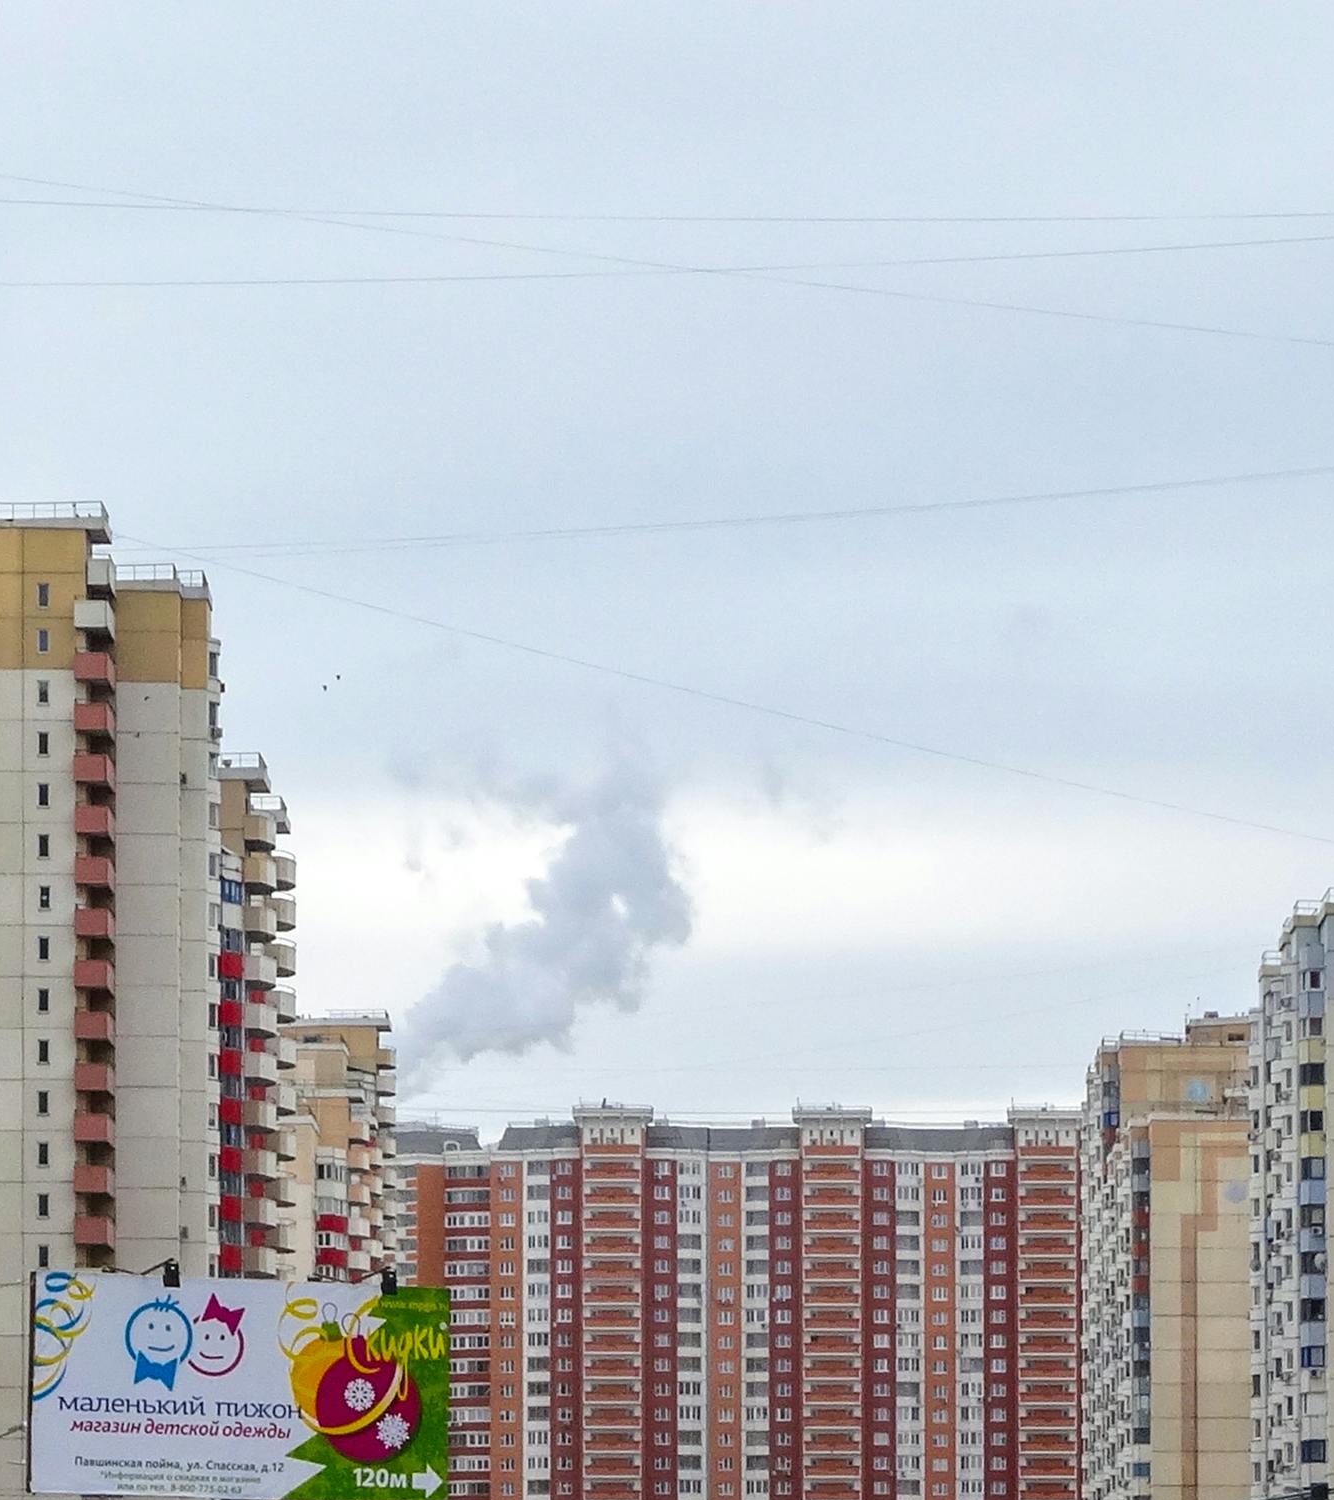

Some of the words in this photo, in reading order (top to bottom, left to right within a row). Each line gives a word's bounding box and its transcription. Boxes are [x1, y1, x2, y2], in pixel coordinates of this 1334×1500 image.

[58, 1395, 206, 1416] маленький
[216, 1400, 304, 1420] пижон
[70, 1420, 141, 1434] магазин
[144, 1418, 219, 1437] детской
[222, 1421, 291, 1439] одежды
[74, 1455, 143, 1468] Павшинская
[186, 1461, 203, 1472] ул.
[206, 1460, 259, 1473] Спасская,
[353, 1467, 407, 1489] 120м
